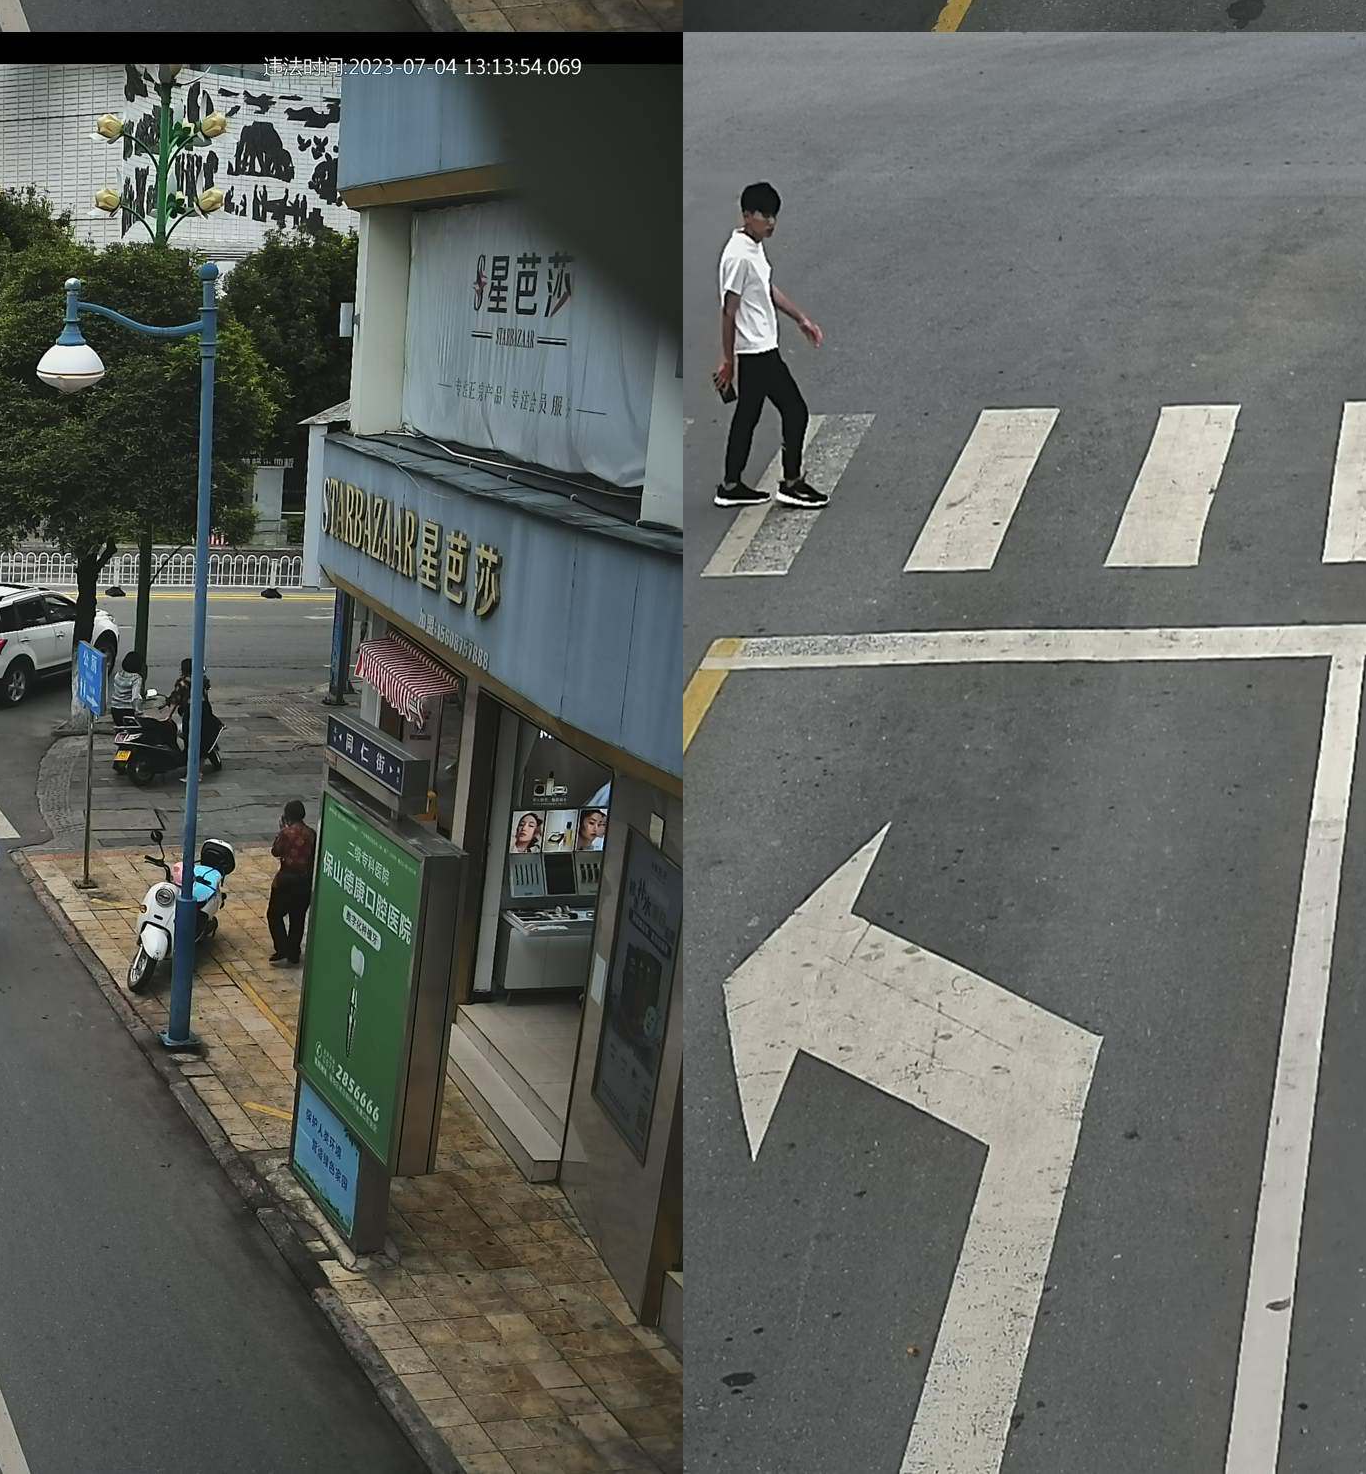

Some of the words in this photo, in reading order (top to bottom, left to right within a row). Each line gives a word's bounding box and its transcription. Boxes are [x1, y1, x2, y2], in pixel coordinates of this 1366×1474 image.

[487, 250, 575, 319] 星芭莎
[321, 476, 418, 579] STARBAZAAR
[417, 517, 502, 618] 星芭莎
[345, 732, 386, 775] 同仁街
[347, 840, 390, 887] 二级专科医院
[323, 850, 413, 945] 保山德康口腔医院
[335, 1063, 380, 1123] 2856666
